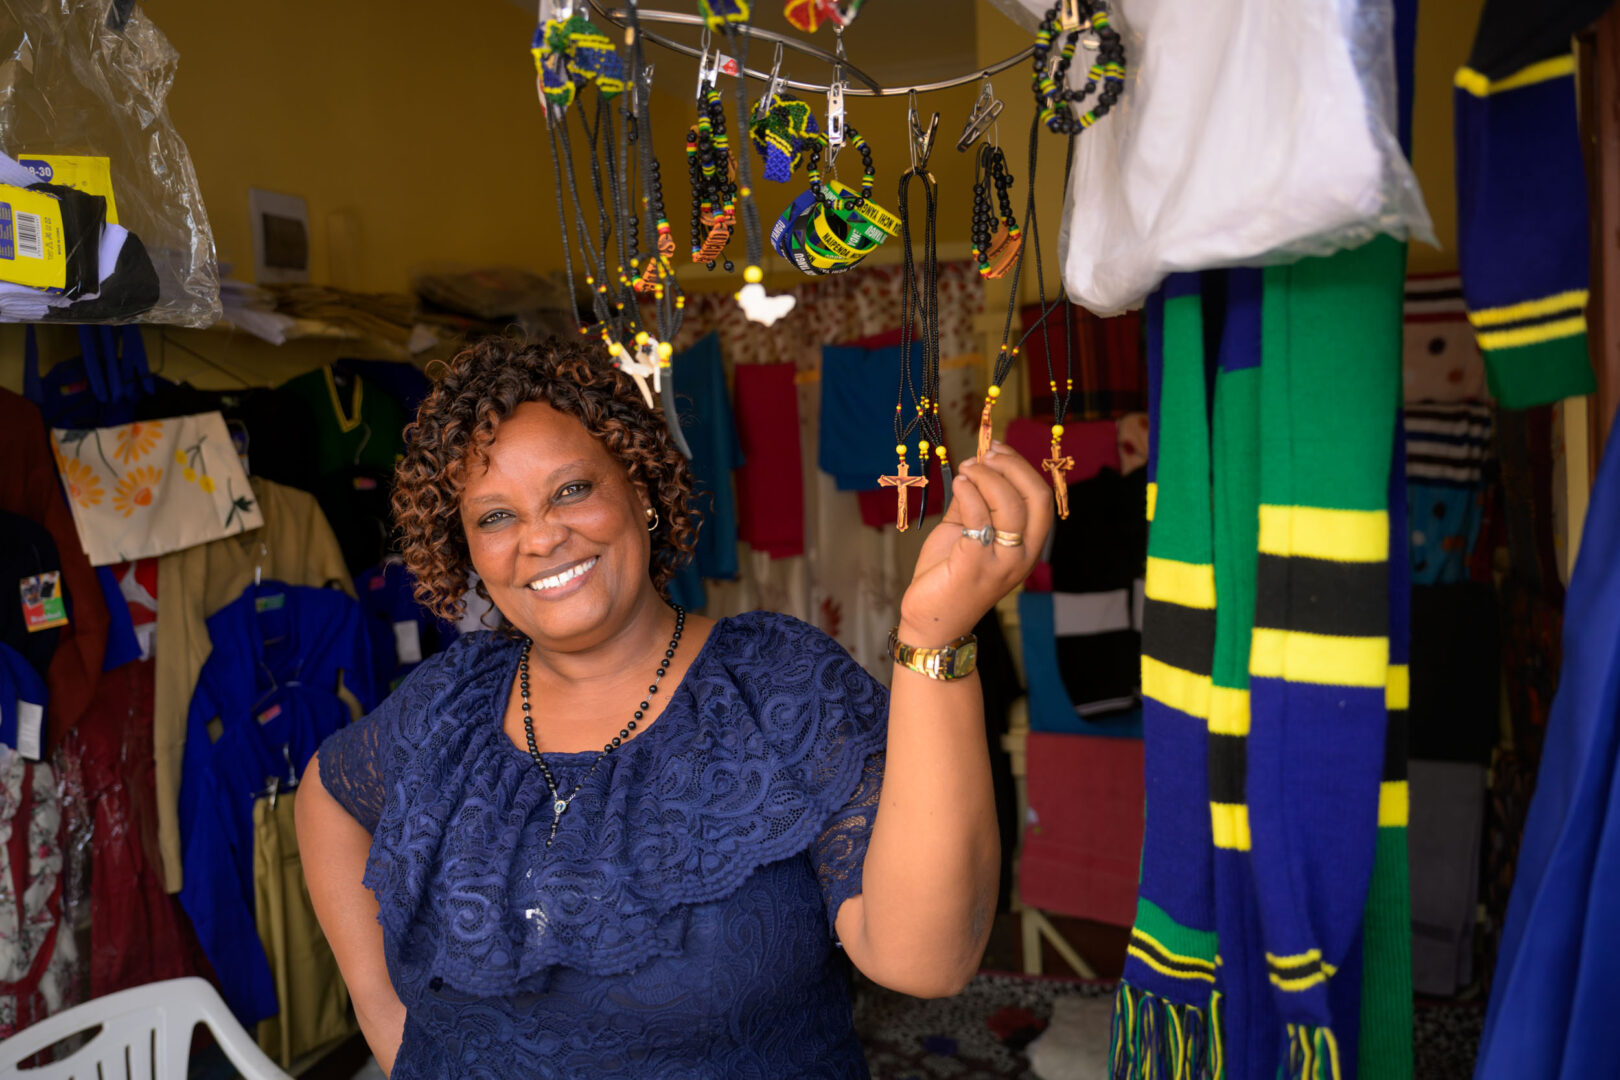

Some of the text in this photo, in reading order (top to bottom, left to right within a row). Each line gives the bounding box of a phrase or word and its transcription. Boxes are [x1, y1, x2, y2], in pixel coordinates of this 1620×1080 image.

[859, 203, 879, 221] YANG
[772, 220, 786, 242] YANGU
[822, 233, 850, 256] NAIPENDA
